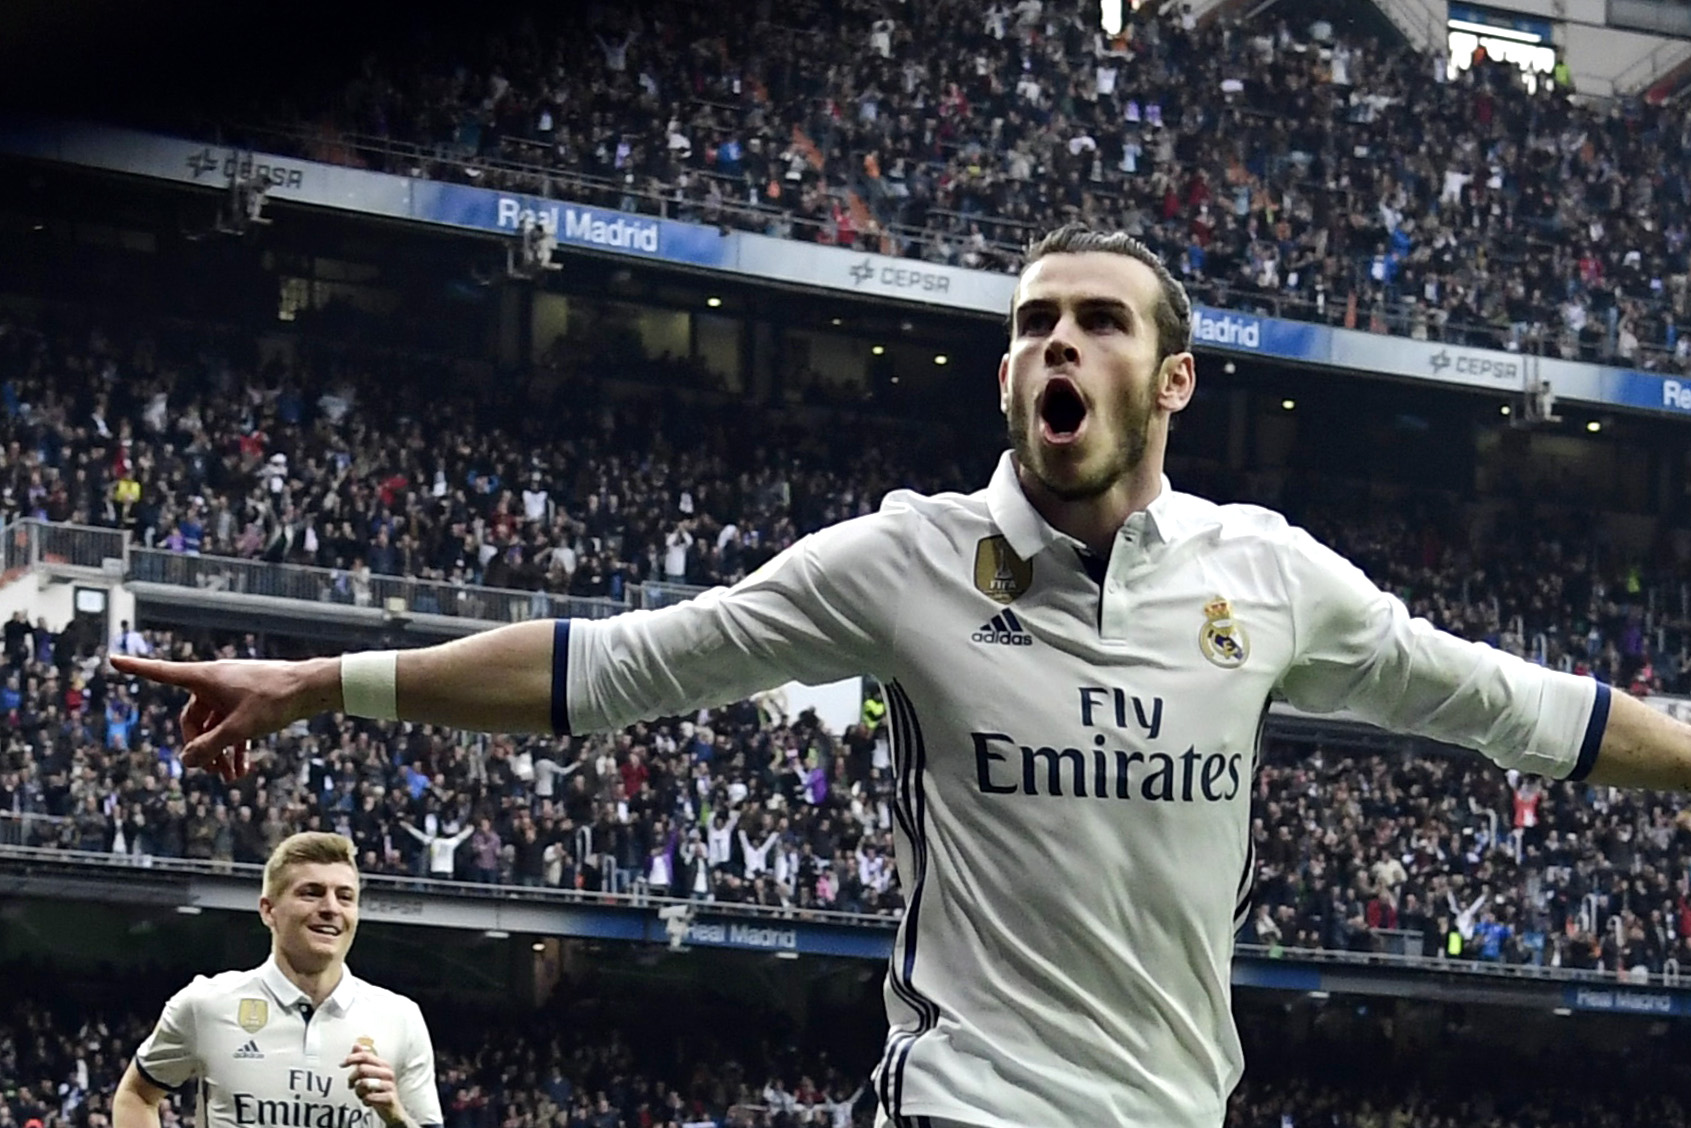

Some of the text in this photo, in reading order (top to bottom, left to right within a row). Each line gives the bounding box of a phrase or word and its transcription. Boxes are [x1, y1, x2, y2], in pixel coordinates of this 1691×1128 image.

[565, 208, 657, 252] Madrid
[880, 266, 951, 294] CEPSA
[1455, 355, 1518, 379] CEPSA
[971, 632, 1033, 646] adidas
[1078, 686, 1163, 739] Fly
[970, 732, 1242, 802] Emirates
[289, 1069, 333, 1098] Fly
